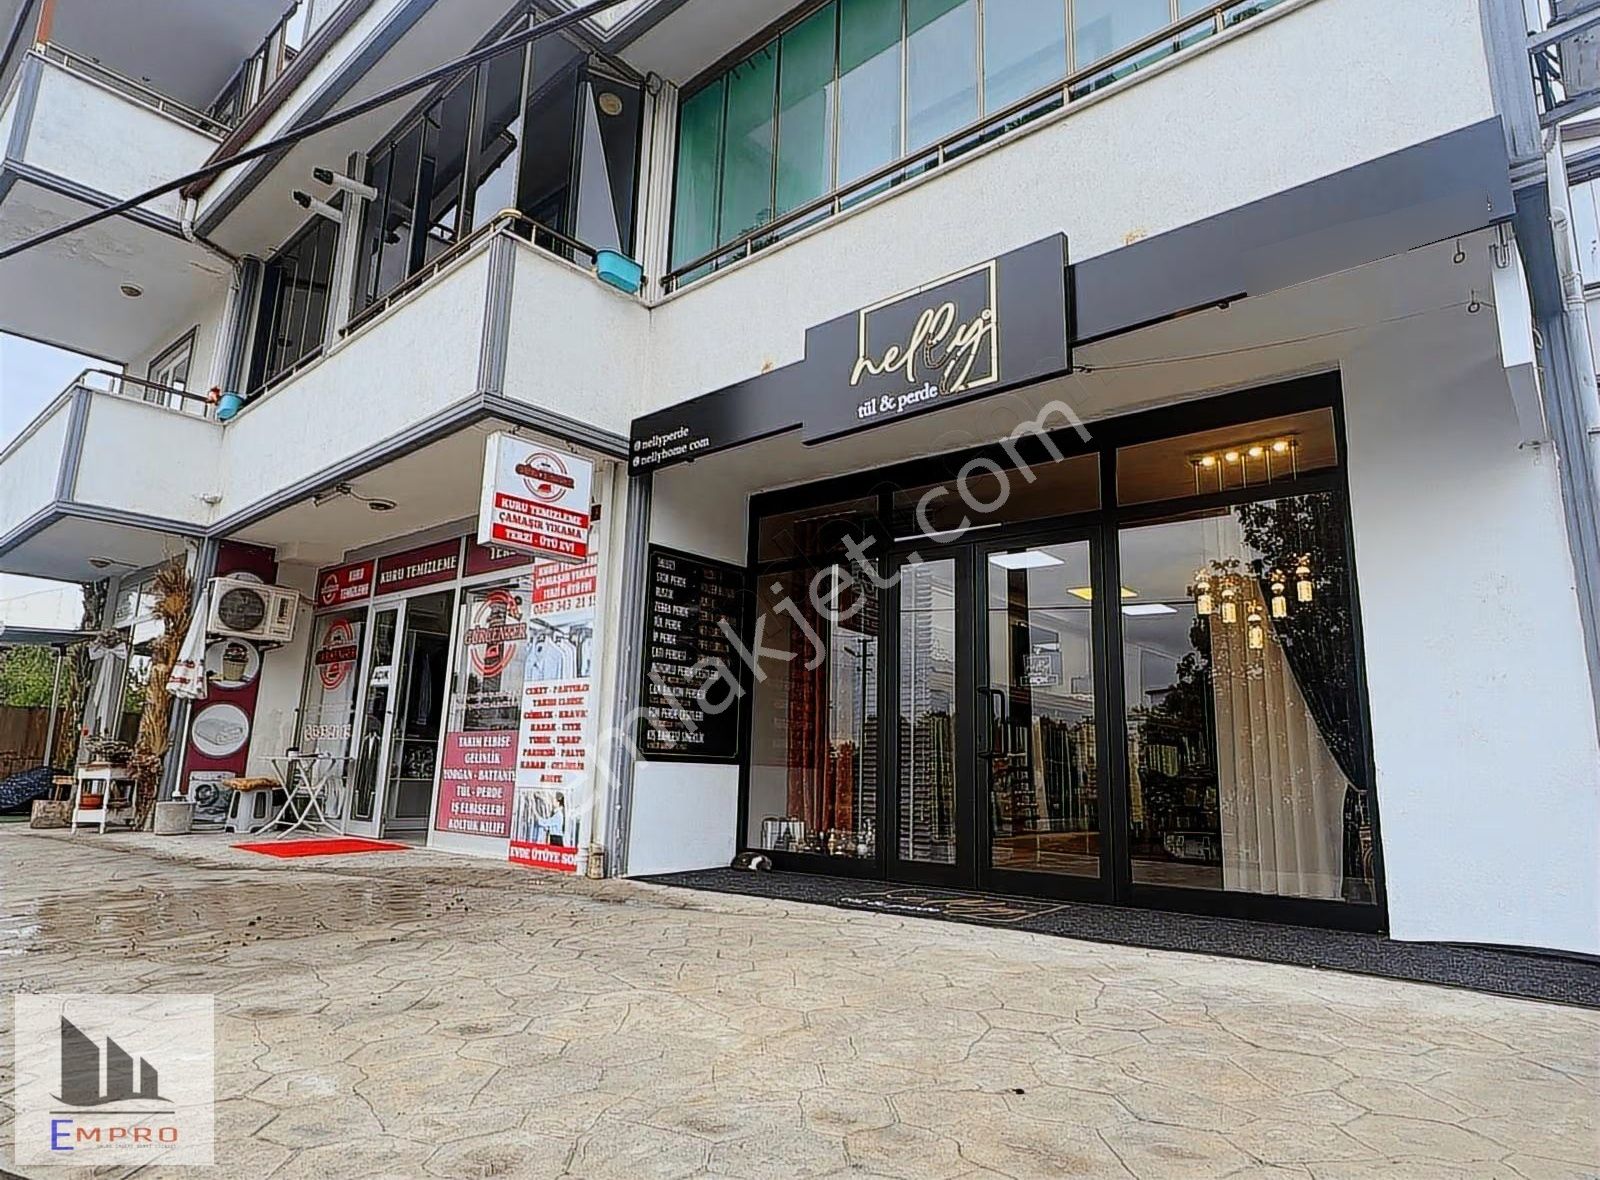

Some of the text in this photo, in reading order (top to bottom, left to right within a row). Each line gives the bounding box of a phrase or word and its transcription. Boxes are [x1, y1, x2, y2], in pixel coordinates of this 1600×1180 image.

[850, 302, 993, 395] nelly
[858, 398, 876, 418] tül
[897, 382, 938, 412] perde
[642, 426, 689, 449] nellyperde
[501, 497, 528, 512] KURU
[499, 511, 582, 539] ÇAMAŞIR YIKAMA
[380, 556, 457, 584] KURU TEMİZLEME
[576, 597, 585, 608] 21
[464, 750, 501, 764] GELİNLİK
[457, 783, 503, 798] TÜL PERDE
[510, 846, 530, 860] EVDE
